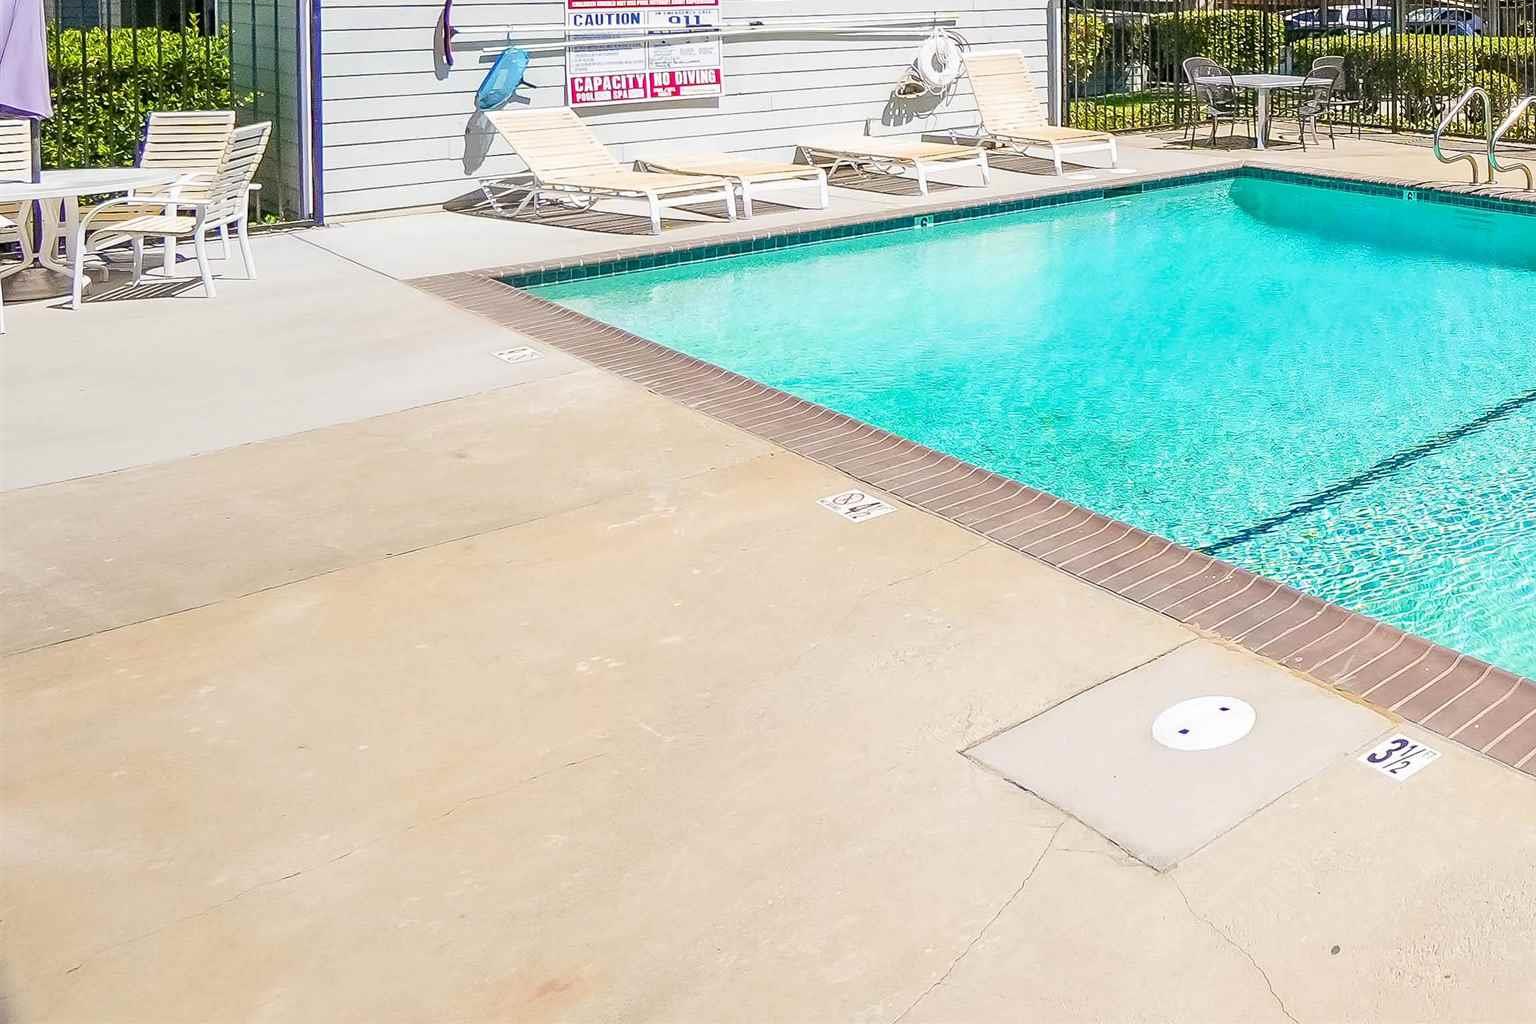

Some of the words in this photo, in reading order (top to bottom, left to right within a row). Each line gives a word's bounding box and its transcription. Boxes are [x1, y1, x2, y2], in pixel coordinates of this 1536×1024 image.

[574, 13, 640, 26] CAUTION
[668, 15, 700, 25] 911
[574, 73, 644, 92] CAPACITY
[653, 72, 670, 87] NO
[674, 69, 716, 85] DIVING
